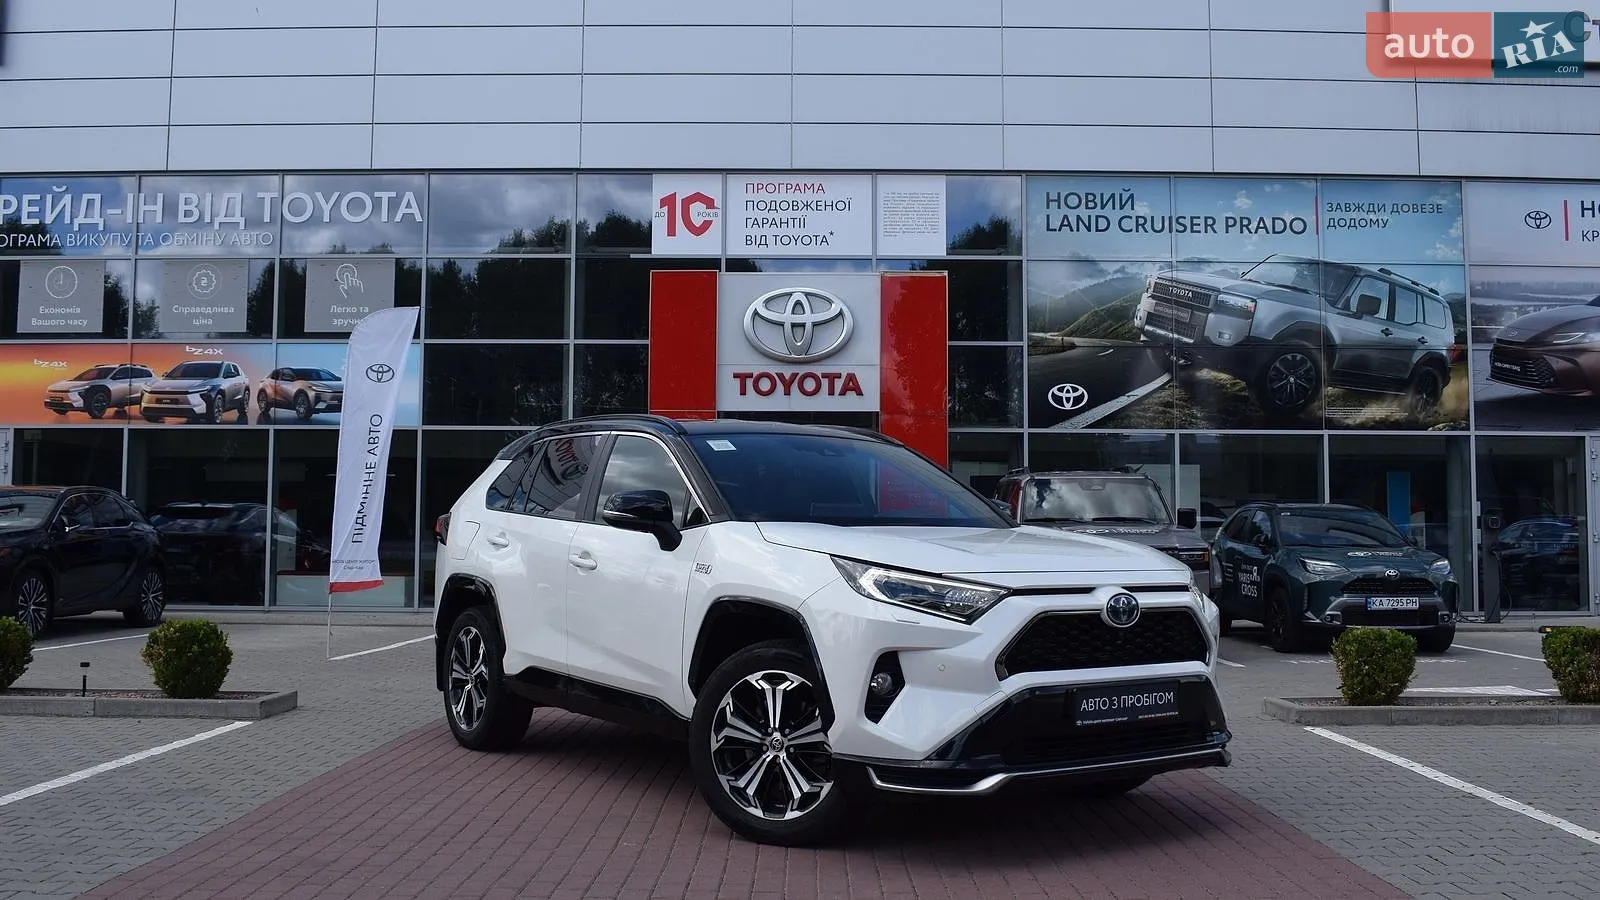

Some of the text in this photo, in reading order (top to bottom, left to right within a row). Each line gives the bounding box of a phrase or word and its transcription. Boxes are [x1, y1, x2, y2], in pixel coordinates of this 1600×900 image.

[745, 183, 825, 194] ПРОГРАМА
[745, 197, 852, 213] ПОДОВЖЕНОЇ
[1045, 188, 1135, 211] НОВИЙ
[178, 192, 245, 230] ВІД
[256, 191, 423, 222] TOYOTA
[1326, 202, 1443, 215] ЗАВЖДИ ДОВЕЗЕ
[1580, 200, 1600, 218] Н
[745, 215, 807, 228] ГАРАНТІЇ
[1046, 214, 1307, 235] LAND CRUISER PRADO
[1327, 217, 1389, 229] ДОДОМУ
[66, 233, 132, 247] ВИКУПУ
[136, 232, 154, 246] ТА
[160, 231, 226, 246] ОБМІНУ
[230, 231, 273, 246] АВТО
[745, 235, 768, 248] ВІД
[1169, 287, 1193, 298] TOYOTA
[39, 305, 81, 314] Економія
[172, 304, 234, 315] Справедлива
[330, 304, 370, 313] Легко та
[31, 318, 88, 327] Вашого часу
[193, 316, 213, 326] ціна
[332, 318, 361, 327] зручн
[732, 372, 863, 396] TOYOTA
[351, 461, 377, 544] ПІДМІННЕ
[367, 413, 383, 457] АВТО
[1386, 598, 1405, 607] 7295
[1080, 691, 1174, 711] АВТО З ПРОБІГОМ
